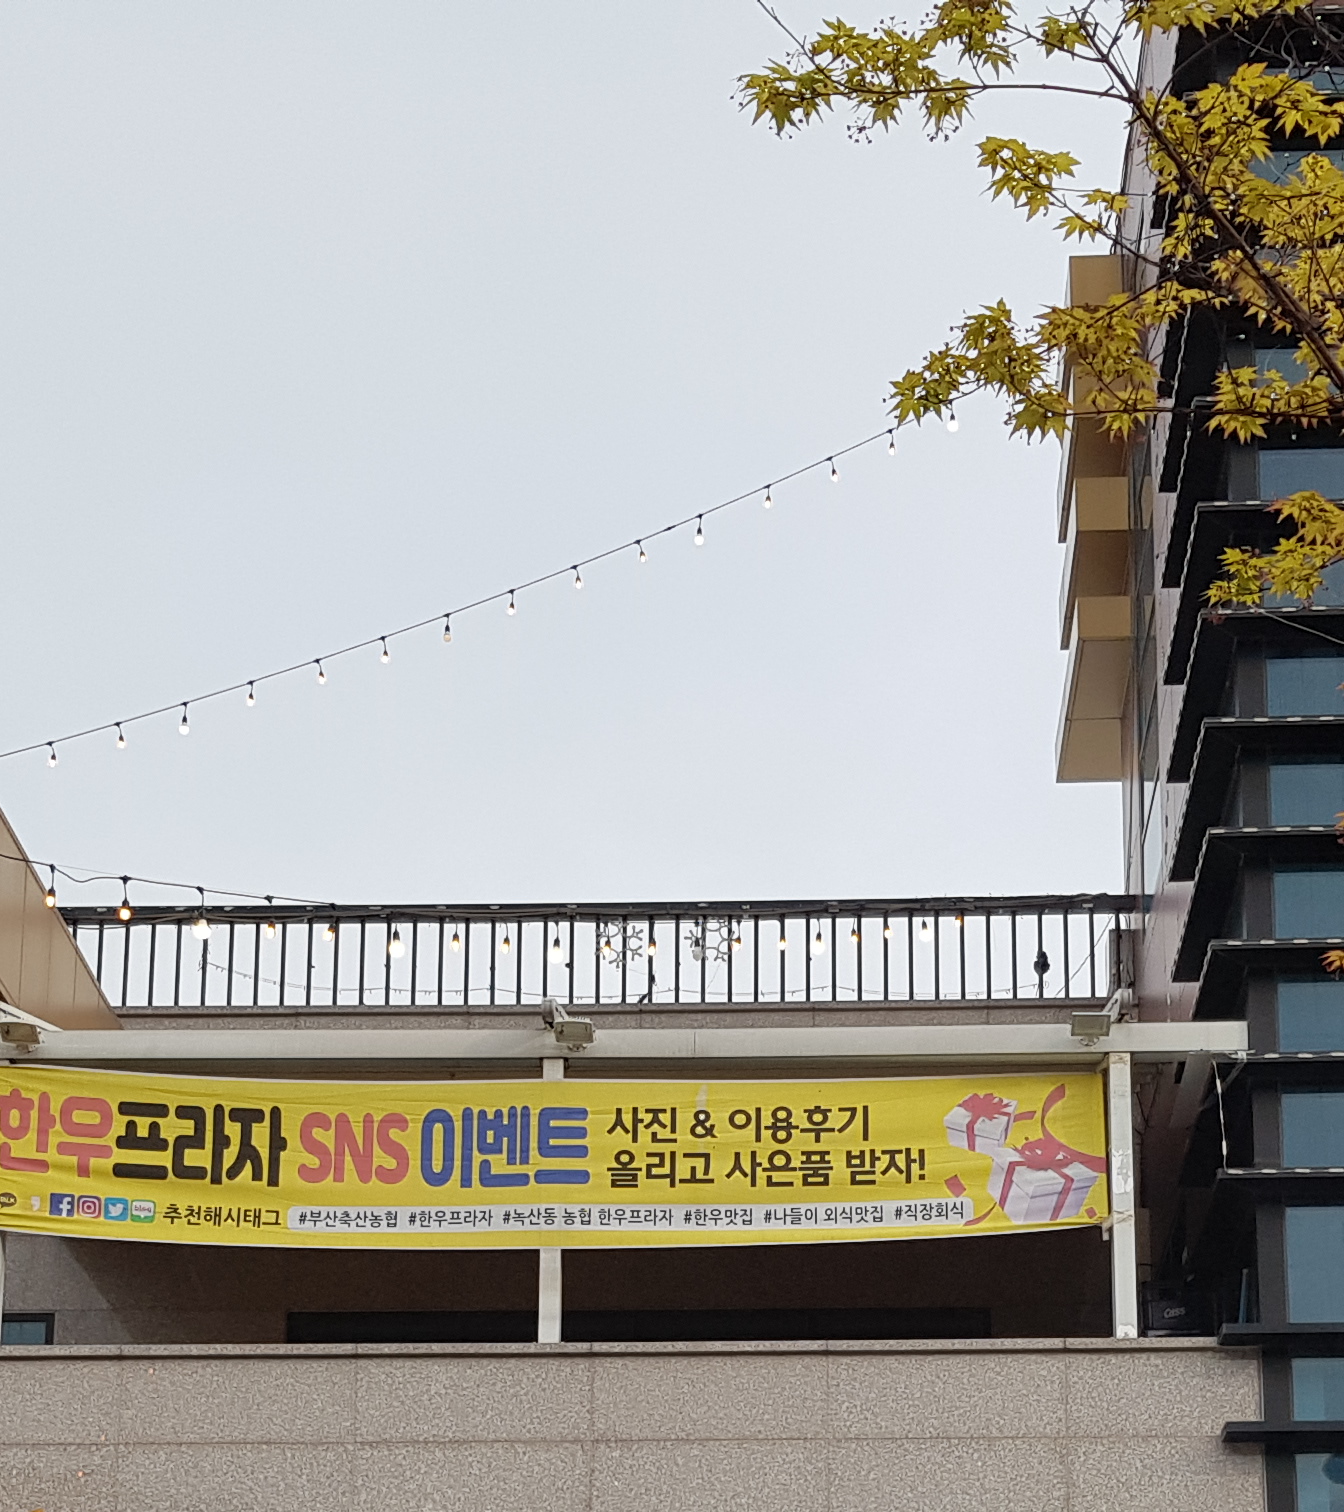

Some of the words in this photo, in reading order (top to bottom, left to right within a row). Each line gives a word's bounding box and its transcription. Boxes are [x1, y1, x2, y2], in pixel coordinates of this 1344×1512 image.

[607, 1105, 677, 1143] 사진
[690, 1107, 718, 1139] &
[728, 1105, 870, 1144] 이용후기
[297, 1111, 410, 1185] SNS
[421, 1106, 590, 1188] 이벤트
[607, 1150, 713, 1188] 올리고
[725, 1149, 833, 1187] 사은품
[845, 1148, 927, 1187] 받자!
[163, 1204, 282, 1228] 추천해시태그
[298, 1209, 398, 1228] #부산축산농협
[408, 1208, 493, 1227] #한우프라자
[502, 1207, 557, 1226] #녹산동
[562, 1207, 592, 1226] 농협
[598, 1207, 674, 1226] 한우프라자
[683, 1207, 753, 1226] #한우맛집
[763, 1206, 818, 1225] #나들이
[823, 1204, 884, 1224] 외식맛집
[894, 1201, 965, 1221] #직장회식
